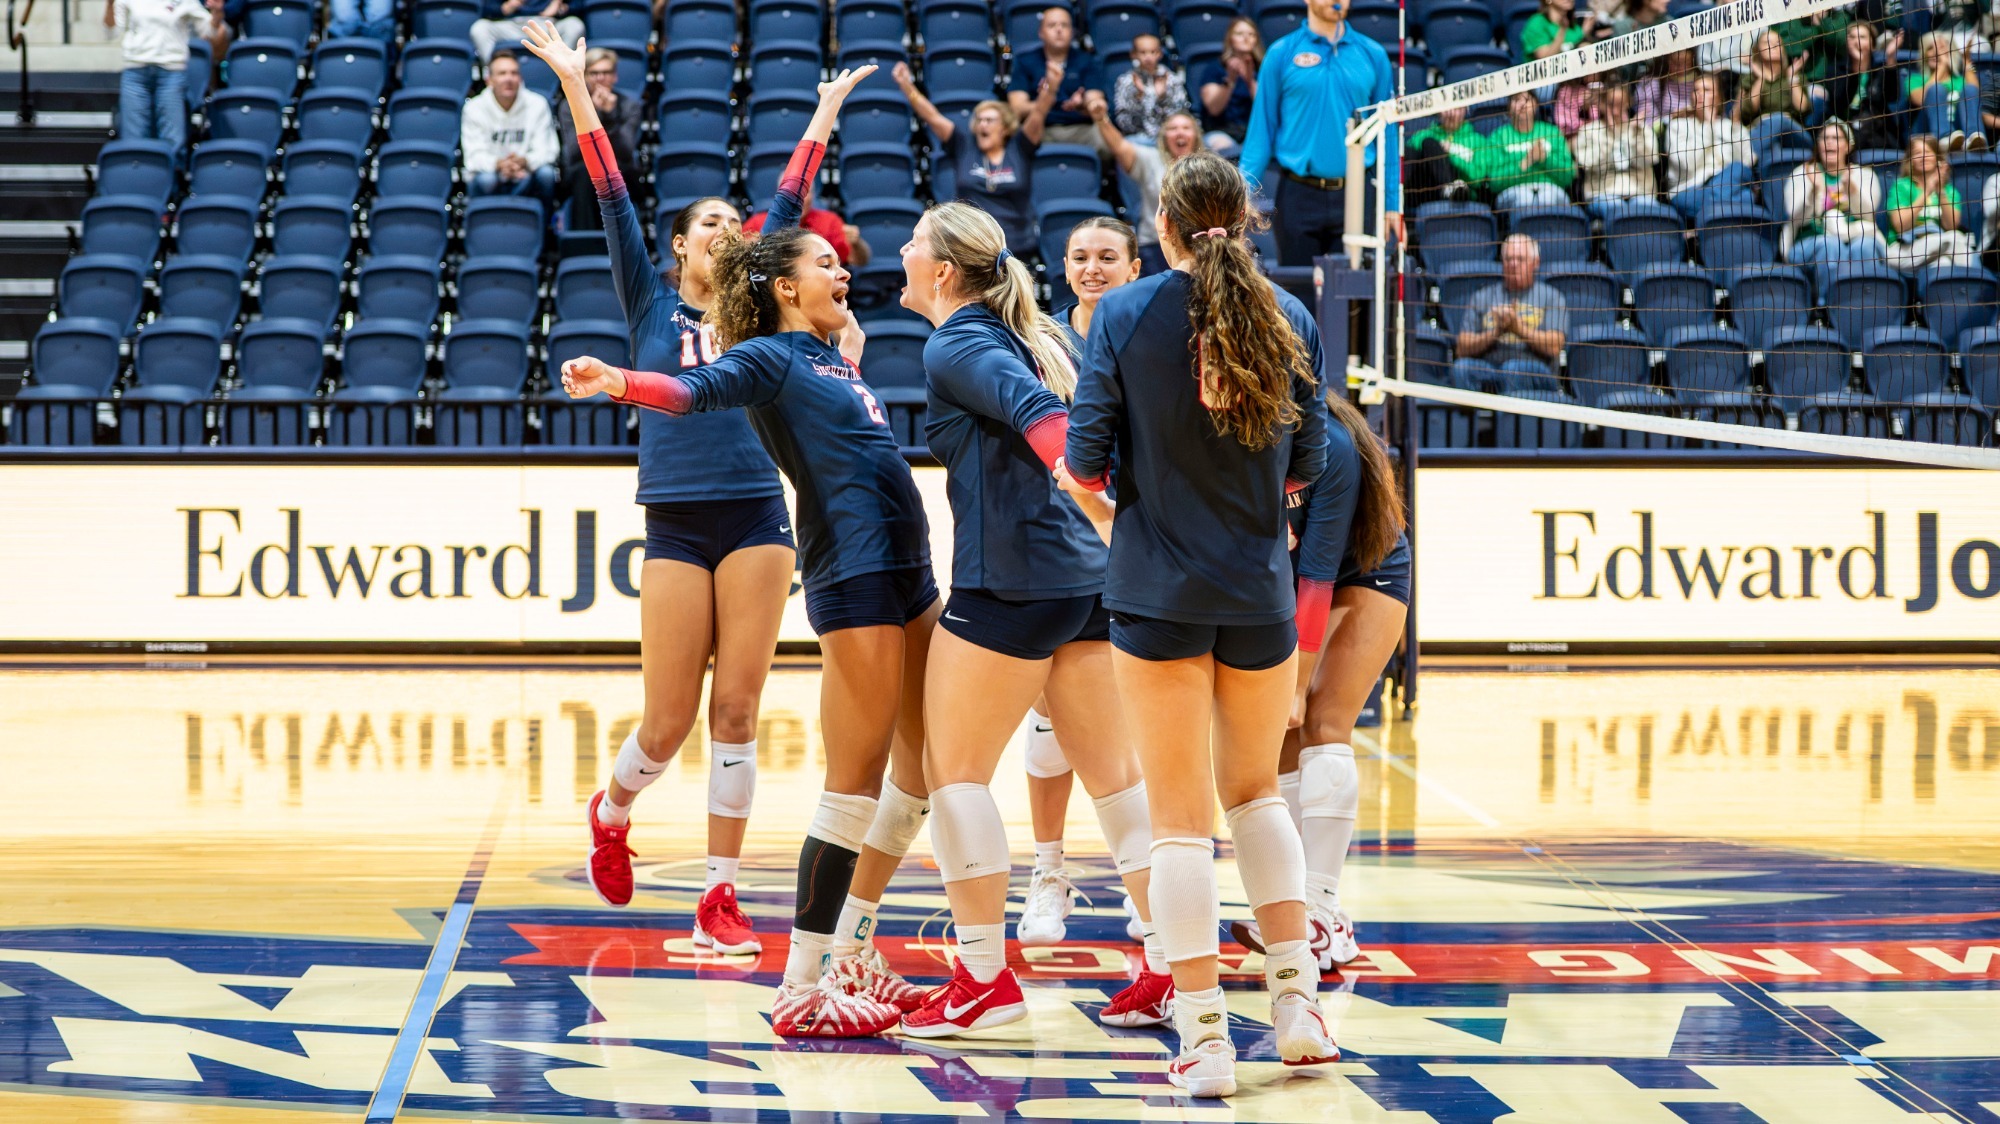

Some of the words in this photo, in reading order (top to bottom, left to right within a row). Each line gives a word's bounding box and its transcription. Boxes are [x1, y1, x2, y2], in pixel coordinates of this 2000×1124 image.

[679, 323, 722, 368] 10
[851, 384, 886, 425] 2
[175, 508, 549, 600] Edward
[1532, 510, 1894, 600] Edward
